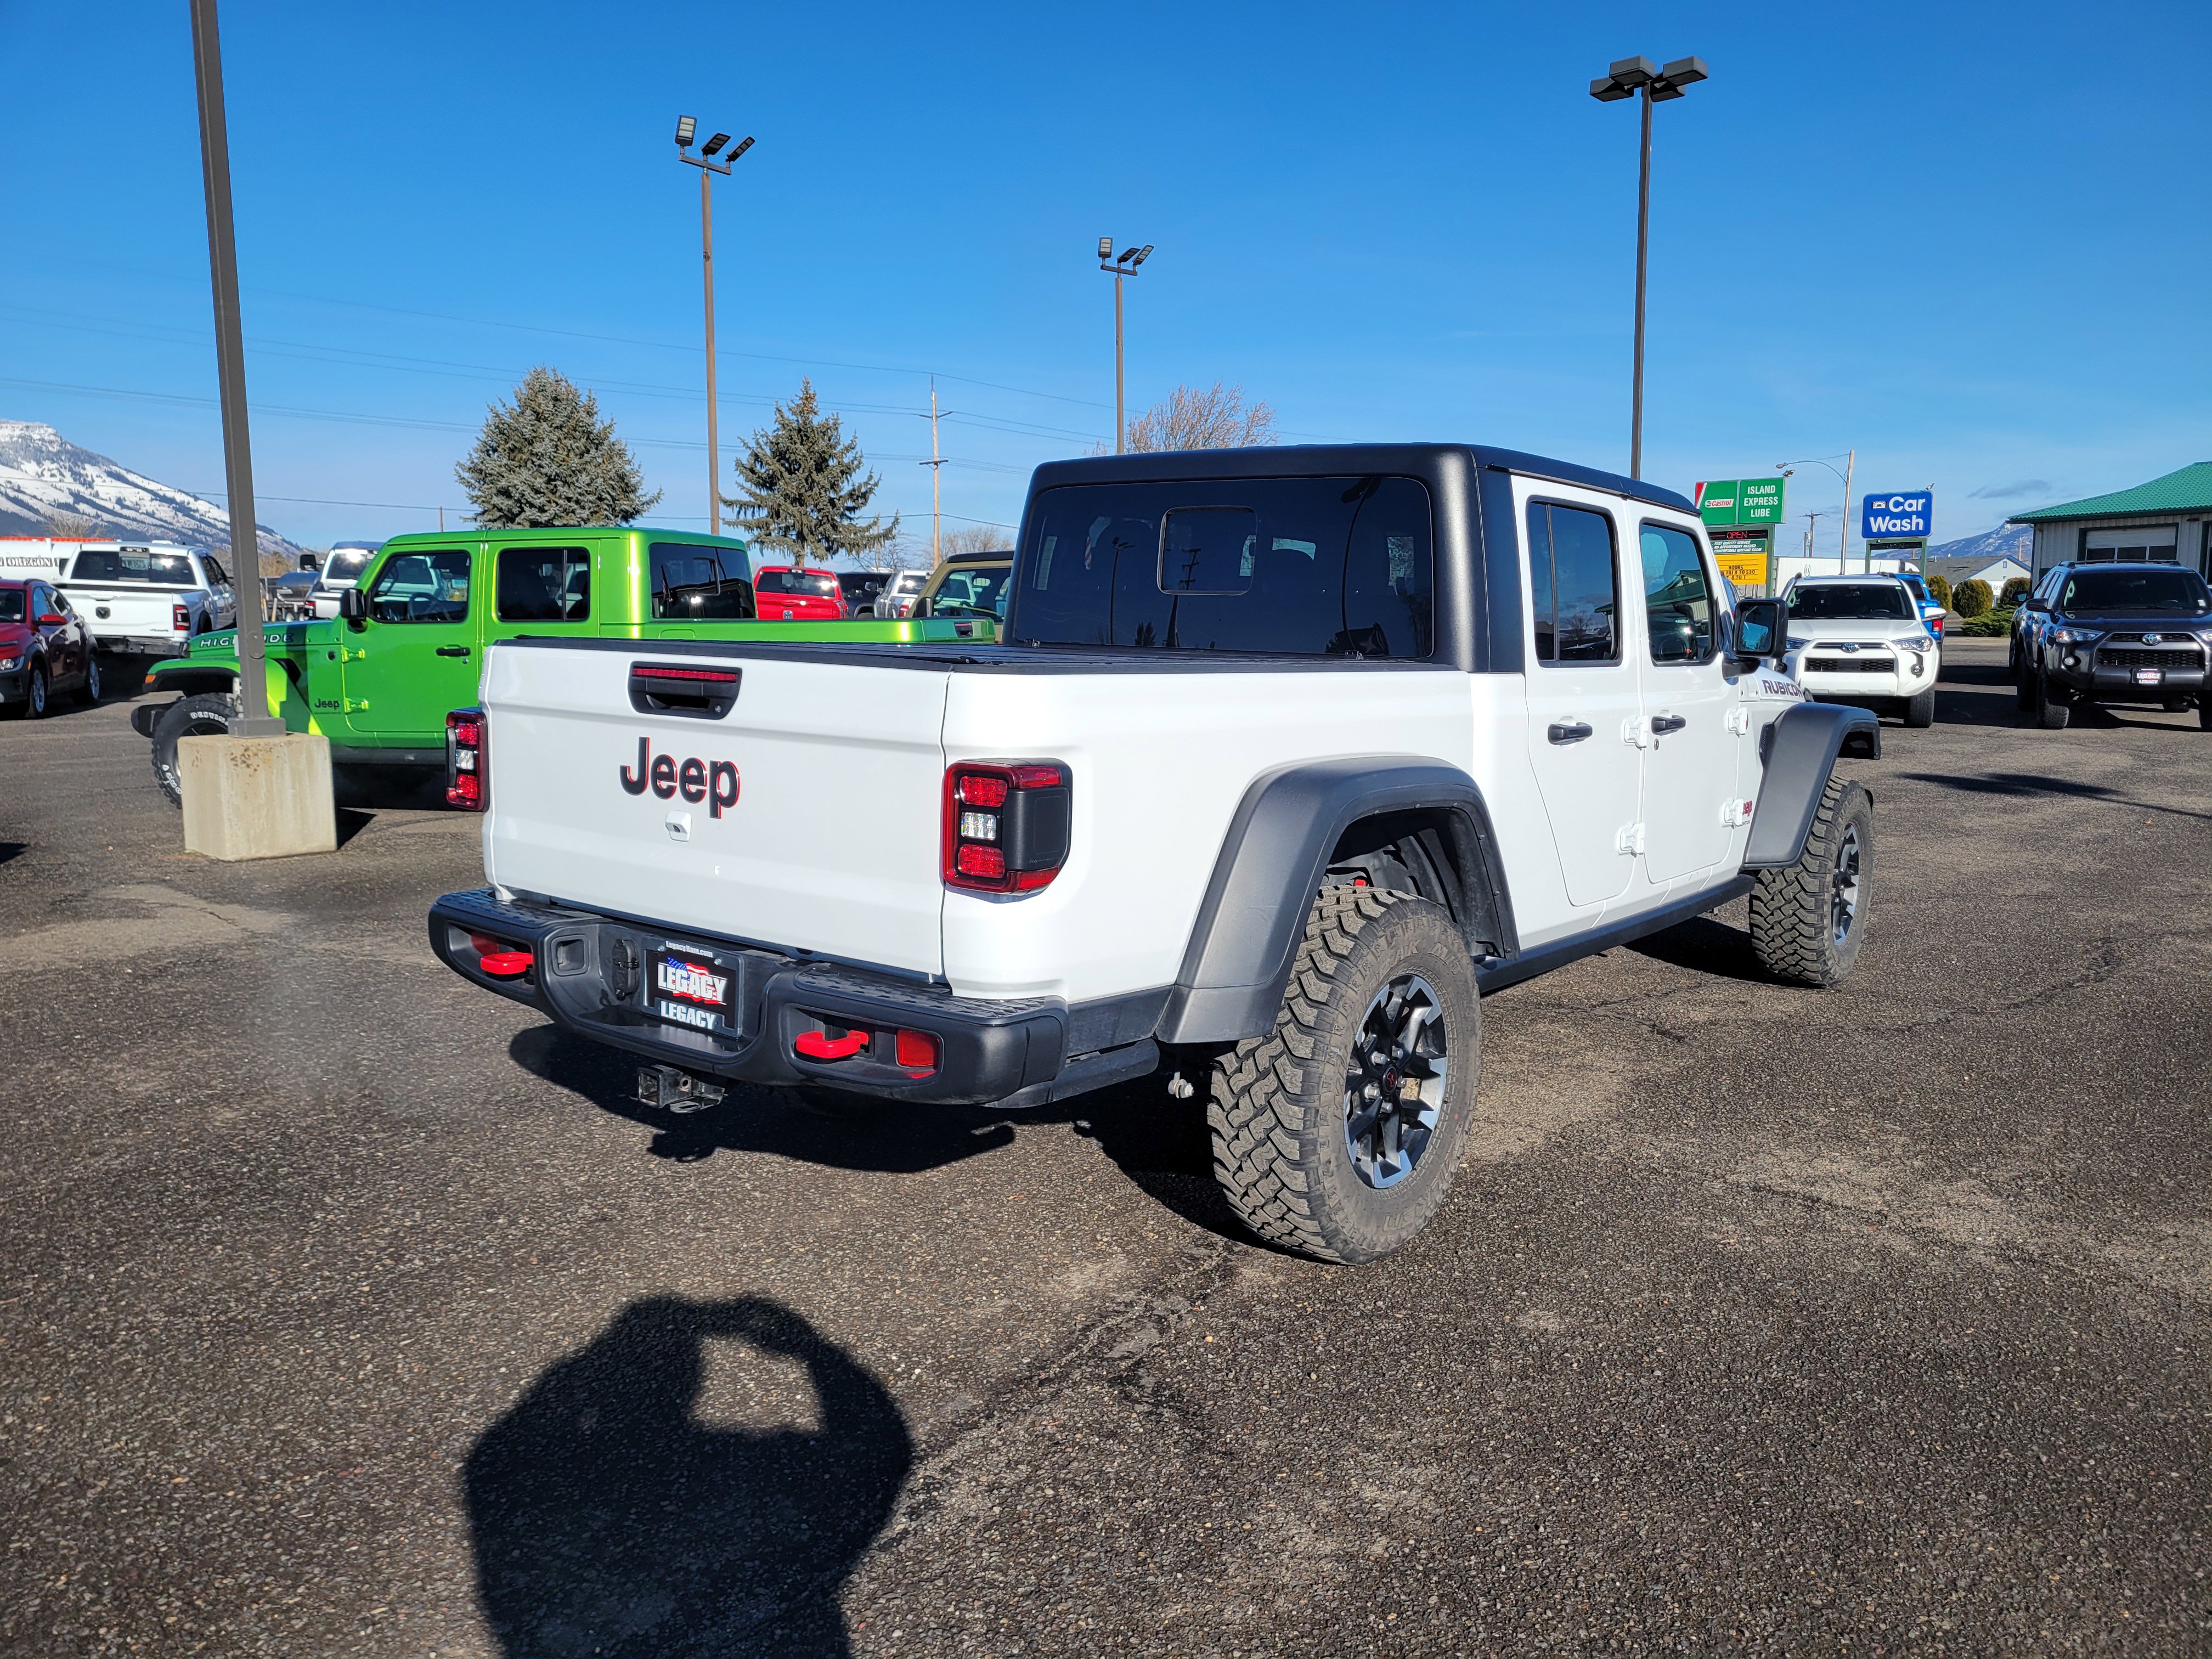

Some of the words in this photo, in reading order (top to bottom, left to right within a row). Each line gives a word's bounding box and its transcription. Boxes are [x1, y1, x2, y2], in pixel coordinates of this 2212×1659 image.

[1747, 485, 1776, 494] ISLAND
[1744, 496, 1779, 506] EXPRESS
[1888, 496, 1925, 512] Car
[1751, 508, 1770, 517] LUBE
[1869, 515, 1923, 532] Wash
[8, 557, 52, 566] OREGON
[264, 633, 294, 642] IDE
[1762, 680, 1803, 698] RUBICON
[314, 698, 340, 710] Jeep
[619, 736, 740, 819] Jeep
[657, 963, 727, 1002] LEGACY
[661, 1001, 716, 1030] LEGACY
